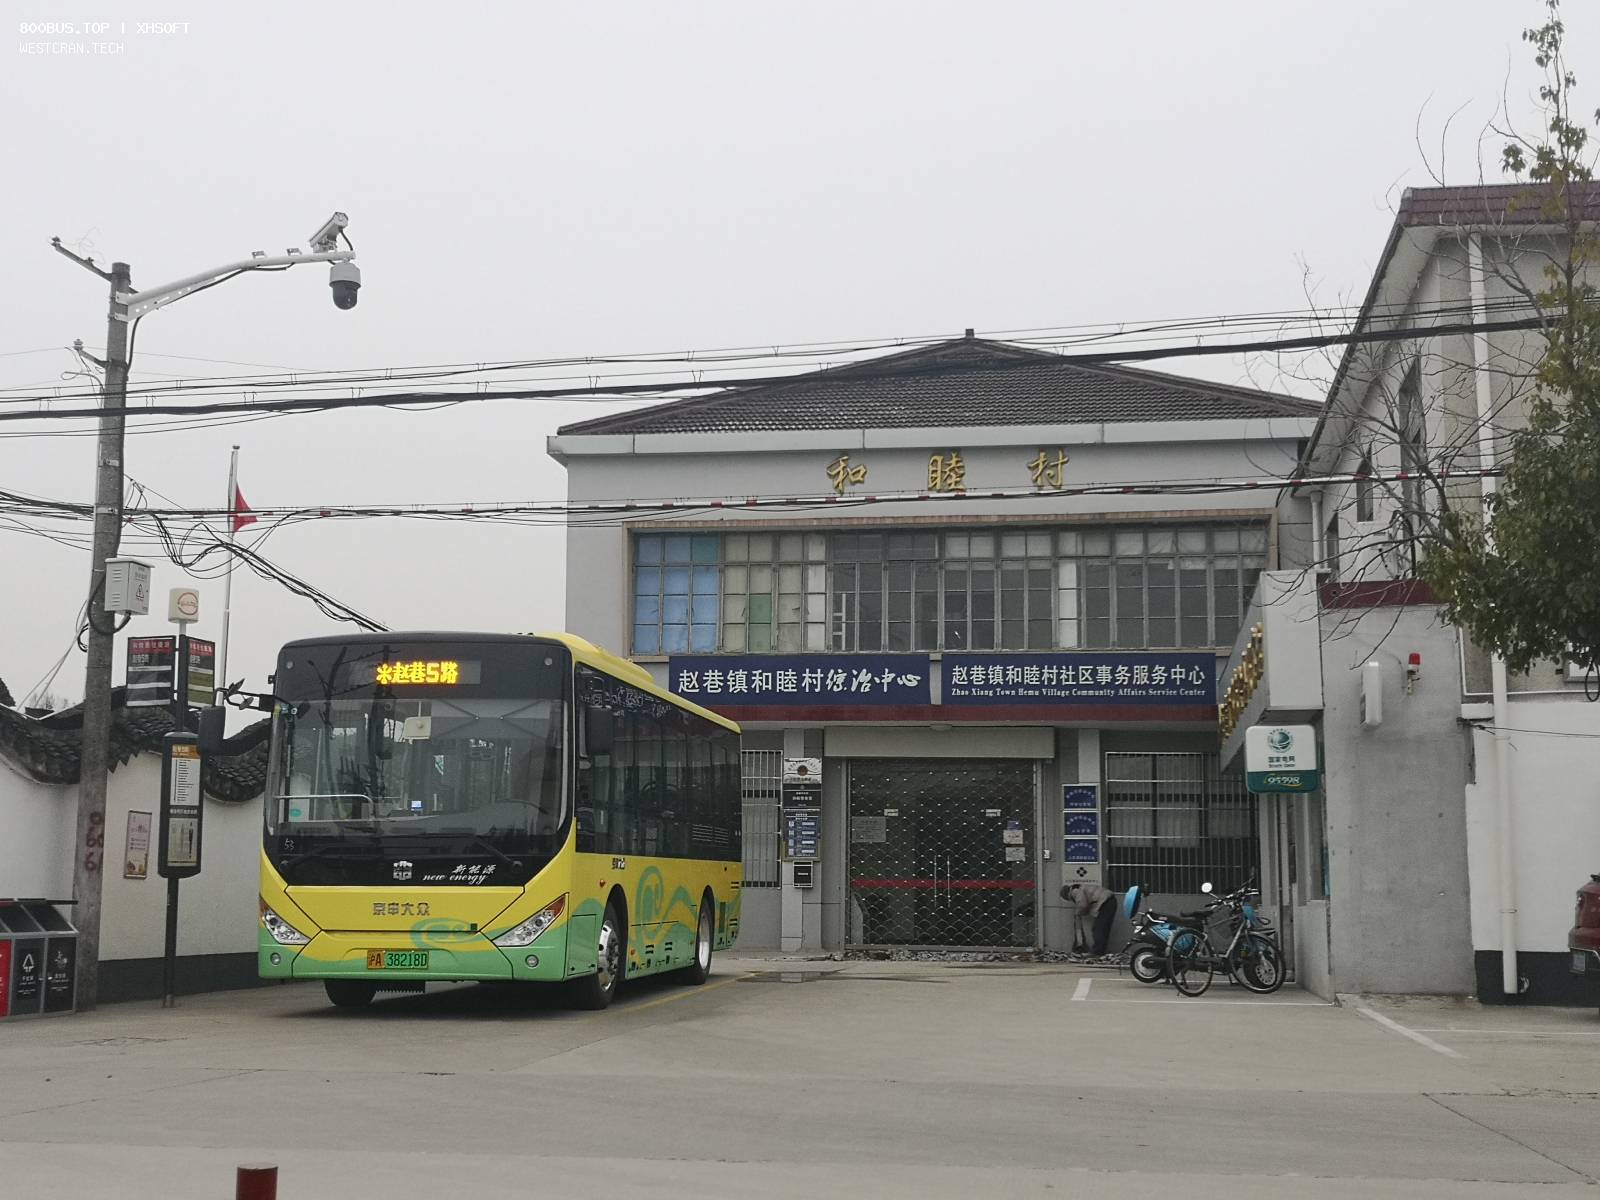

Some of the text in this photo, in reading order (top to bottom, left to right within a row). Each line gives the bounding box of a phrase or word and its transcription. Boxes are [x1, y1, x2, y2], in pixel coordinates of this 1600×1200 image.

[826, 450, 1070, 496] 和睦村
[678, 668, 921, 693] 赵巷镇和睦村综治中心
[951, 664, 1206, 686] 赵巷镇和睦村社区事务服务中心
[951, 688, 1206, 697] Zhao Xiang Town Hemu Village Community Affairs Service Center
[451, 864, 497, 875] 新能源
[449, 873, 487, 885] energy
